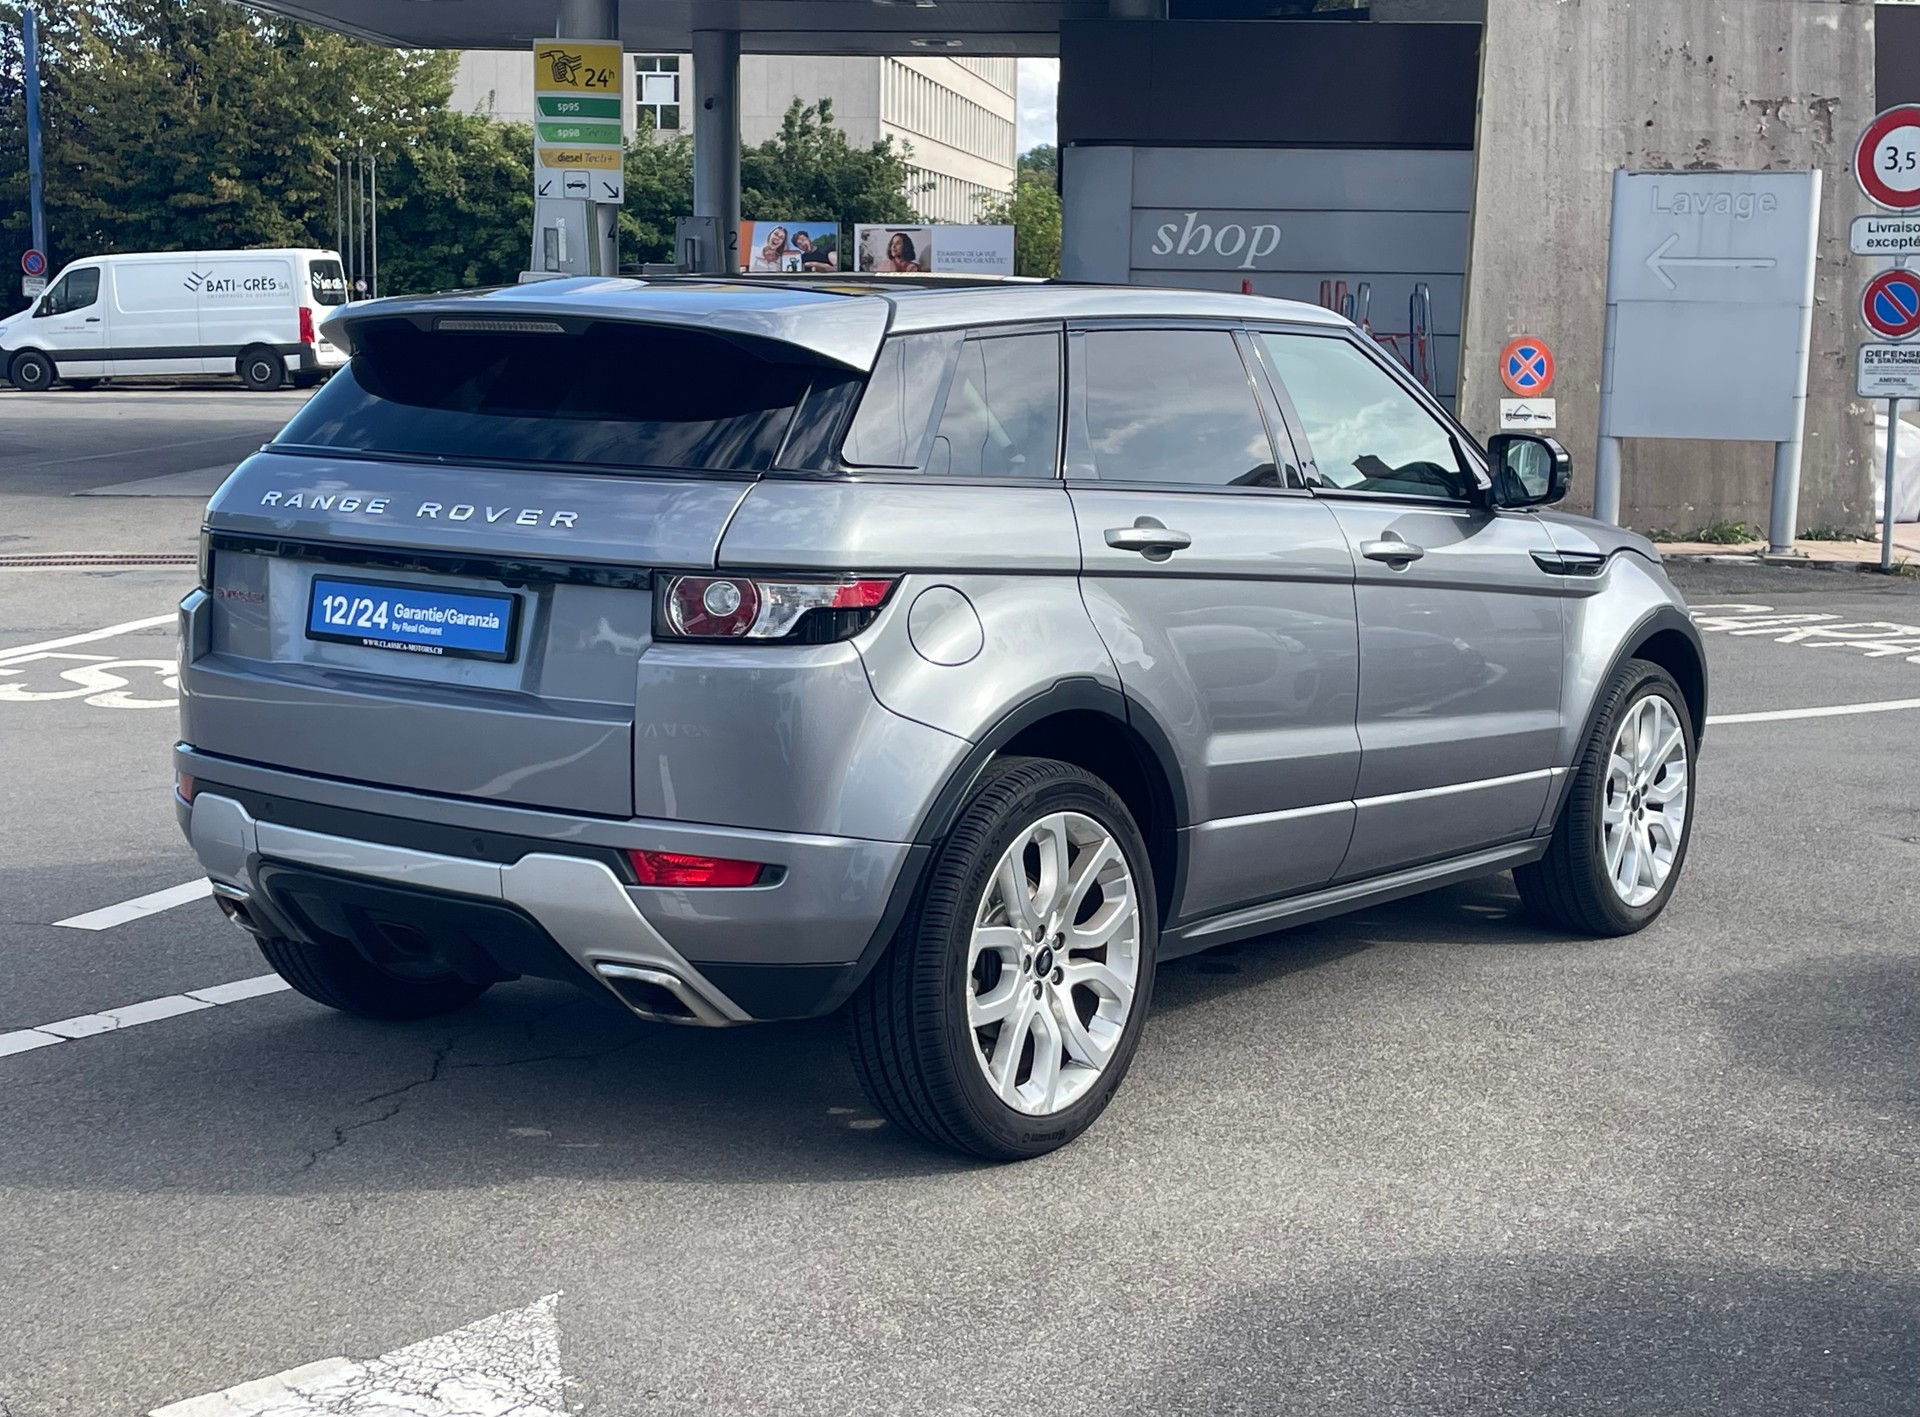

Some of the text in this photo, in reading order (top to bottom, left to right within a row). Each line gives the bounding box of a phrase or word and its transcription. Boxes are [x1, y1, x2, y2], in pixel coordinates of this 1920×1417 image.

[557, 102, 580, 113] sp95
[557, 128, 580, 139] sp98
[557, 151, 583, 163] diesel
[1884, 146, 1916, 173] 3,5
[1651, 185, 1777, 220] Lavage
[607, 224, 615, 244] 4
[728, 230, 738, 250] 2
[1151, 212, 1282, 269] shop
[278, 281, 289, 290] SA
[260, 490, 579, 529] RANGE ROVER
[322, 595, 500, 630] 12/24 Garantie/Garanzia
[391, 621, 442, 636] by Real Garant
